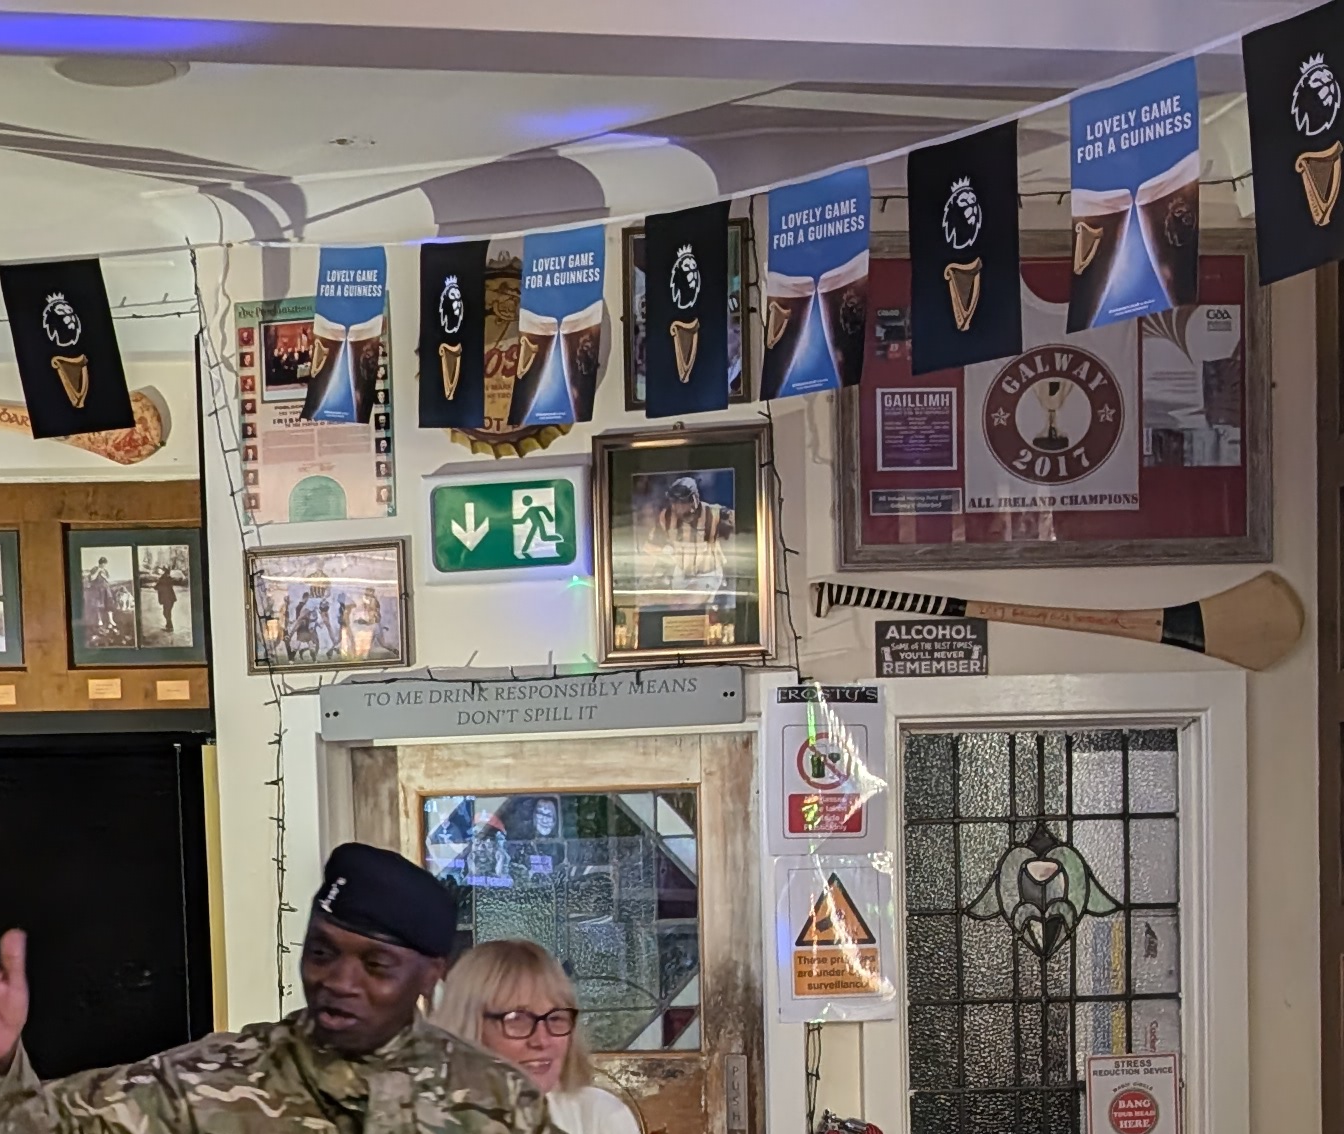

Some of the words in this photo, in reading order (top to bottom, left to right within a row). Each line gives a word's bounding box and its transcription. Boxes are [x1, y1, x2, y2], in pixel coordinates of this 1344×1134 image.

[1086, 111, 1137, 141] LOVELY
[1142, 95, 1182, 122] GAME
[1077, 144, 1104, 164] FOR
[1108, 137, 1117, 153] A
[1121, 112, 1192, 150] GUINNESS
[781, 209, 823, 229] LOVELY
[826, 199, 857, 217] GAME
[773, 231, 796, 248] FOR
[798, 228, 805, 242] A
[807, 214, 865, 241] GUINNESS
[533, 256, 565, 272] LOVELY
[568, 252, 594, 268] GAME
[327, 270, 354, 283] LOVELY
[356, 269, 377, 282] GAME
[525, 276, 542, 289] FOR
[545, 274, 551, 287] A
[554, 269, 600, 286] GUINNESS
[320, 284, 335, 298] FOR
[336, 283, 341, 297] A
[342, 282, 382, 298] GUINNESS
[1002, 353, 1108, 394] GALWAY
[884, 394, 950, 407] GAILLIMH
[1012, 447, 1091, 476] 2017
[968, 496, 993, 507] ALL
[998, 495, 1056, 507] IRELAND
[1060, 494, 1138, 506] CHAMPIONS
[885, 625, 977, 640] ALCOHOL
[920, 642, 931, 650] THE
[935, 641, 950, 649] BEST
[952, 641, 973, 649] TIMES
[883, 655, 986, 675] REMEMBER!
[364, 691, 390, 706] TO
[394, 691, 424, 705] ME
[428, 687, 490, 704] DRINK
[493, 680, 623, 702] RESPONSIBLY
[629, 677, 698, 698] MEANS
[778, 688, 877, 702] FROSTY'S
[457, 708, 518, 726] DON'T
[524, 706, 572, 724] SPILL
[578, 704, 598, 721] IT
[798, 955, 827, 965] These
[818, 969, 844, 977] under
[808, 982, 872, 991] surveillanc
[1114, 1060, 1152, 1068] STRESS
[731, 1065, 741, 1123] PUSH
[1119, 1100, 1150, 1108] BANG
[1120, 1119, 1150, 1128] HERE
